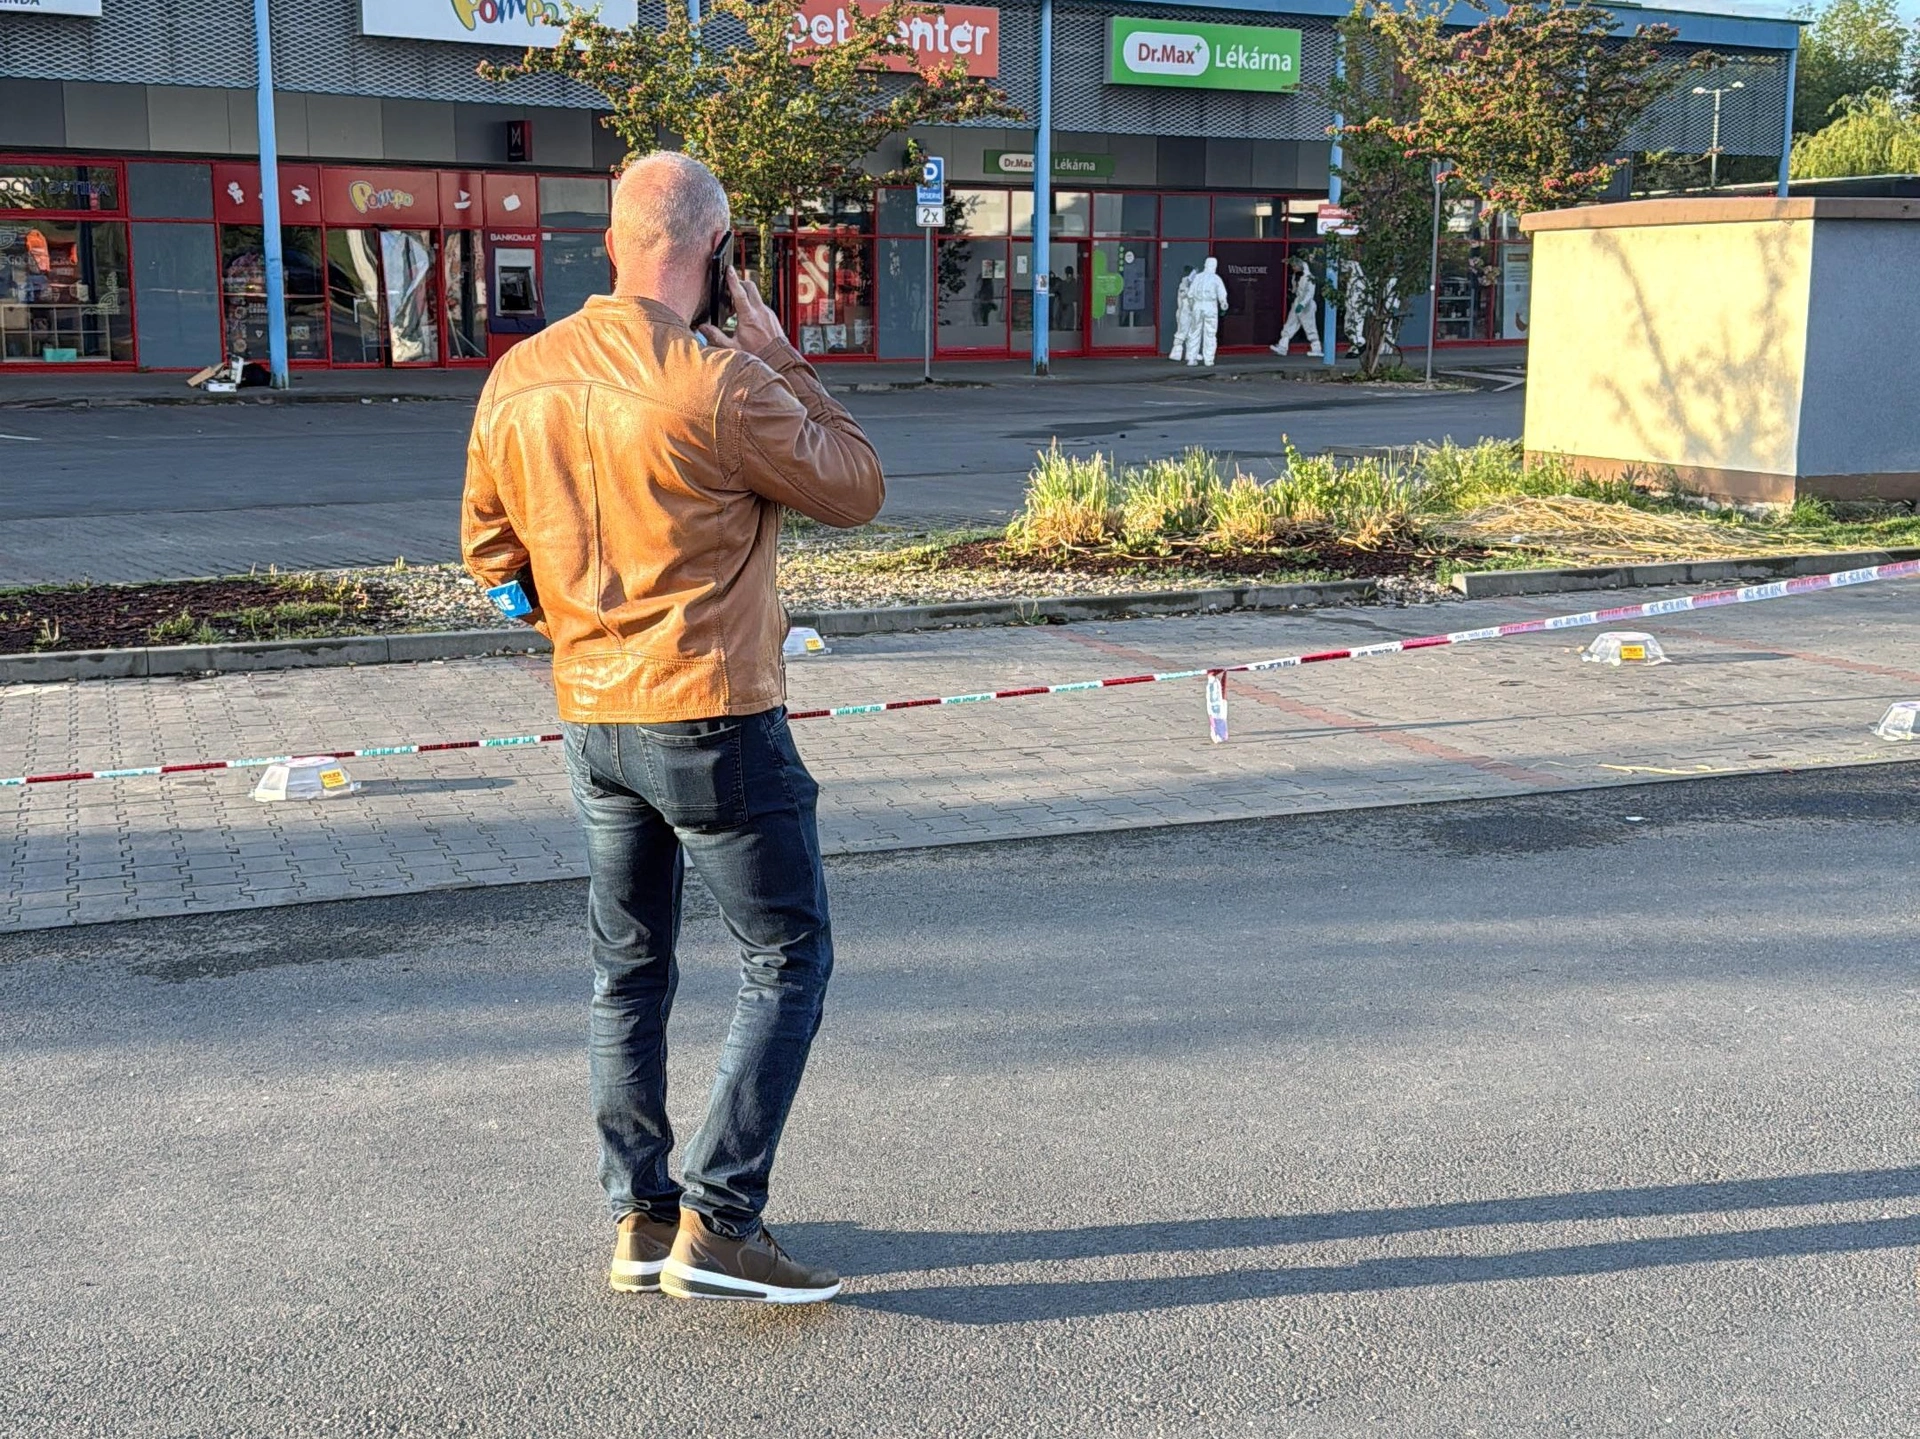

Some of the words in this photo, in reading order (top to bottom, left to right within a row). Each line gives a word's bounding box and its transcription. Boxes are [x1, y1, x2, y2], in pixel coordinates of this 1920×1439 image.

[786, 8, 850, 51] pet
[887, 15, 990, 56] enter
[1215, 44, 1292, 72] Lékárna
[1054, 158, 1096, 171] Lékárna
[349, 180, 414, 214] Pompo
[922, 207, 939, 223] 2x
[490, 233, 537, 242] BANKOMAT
